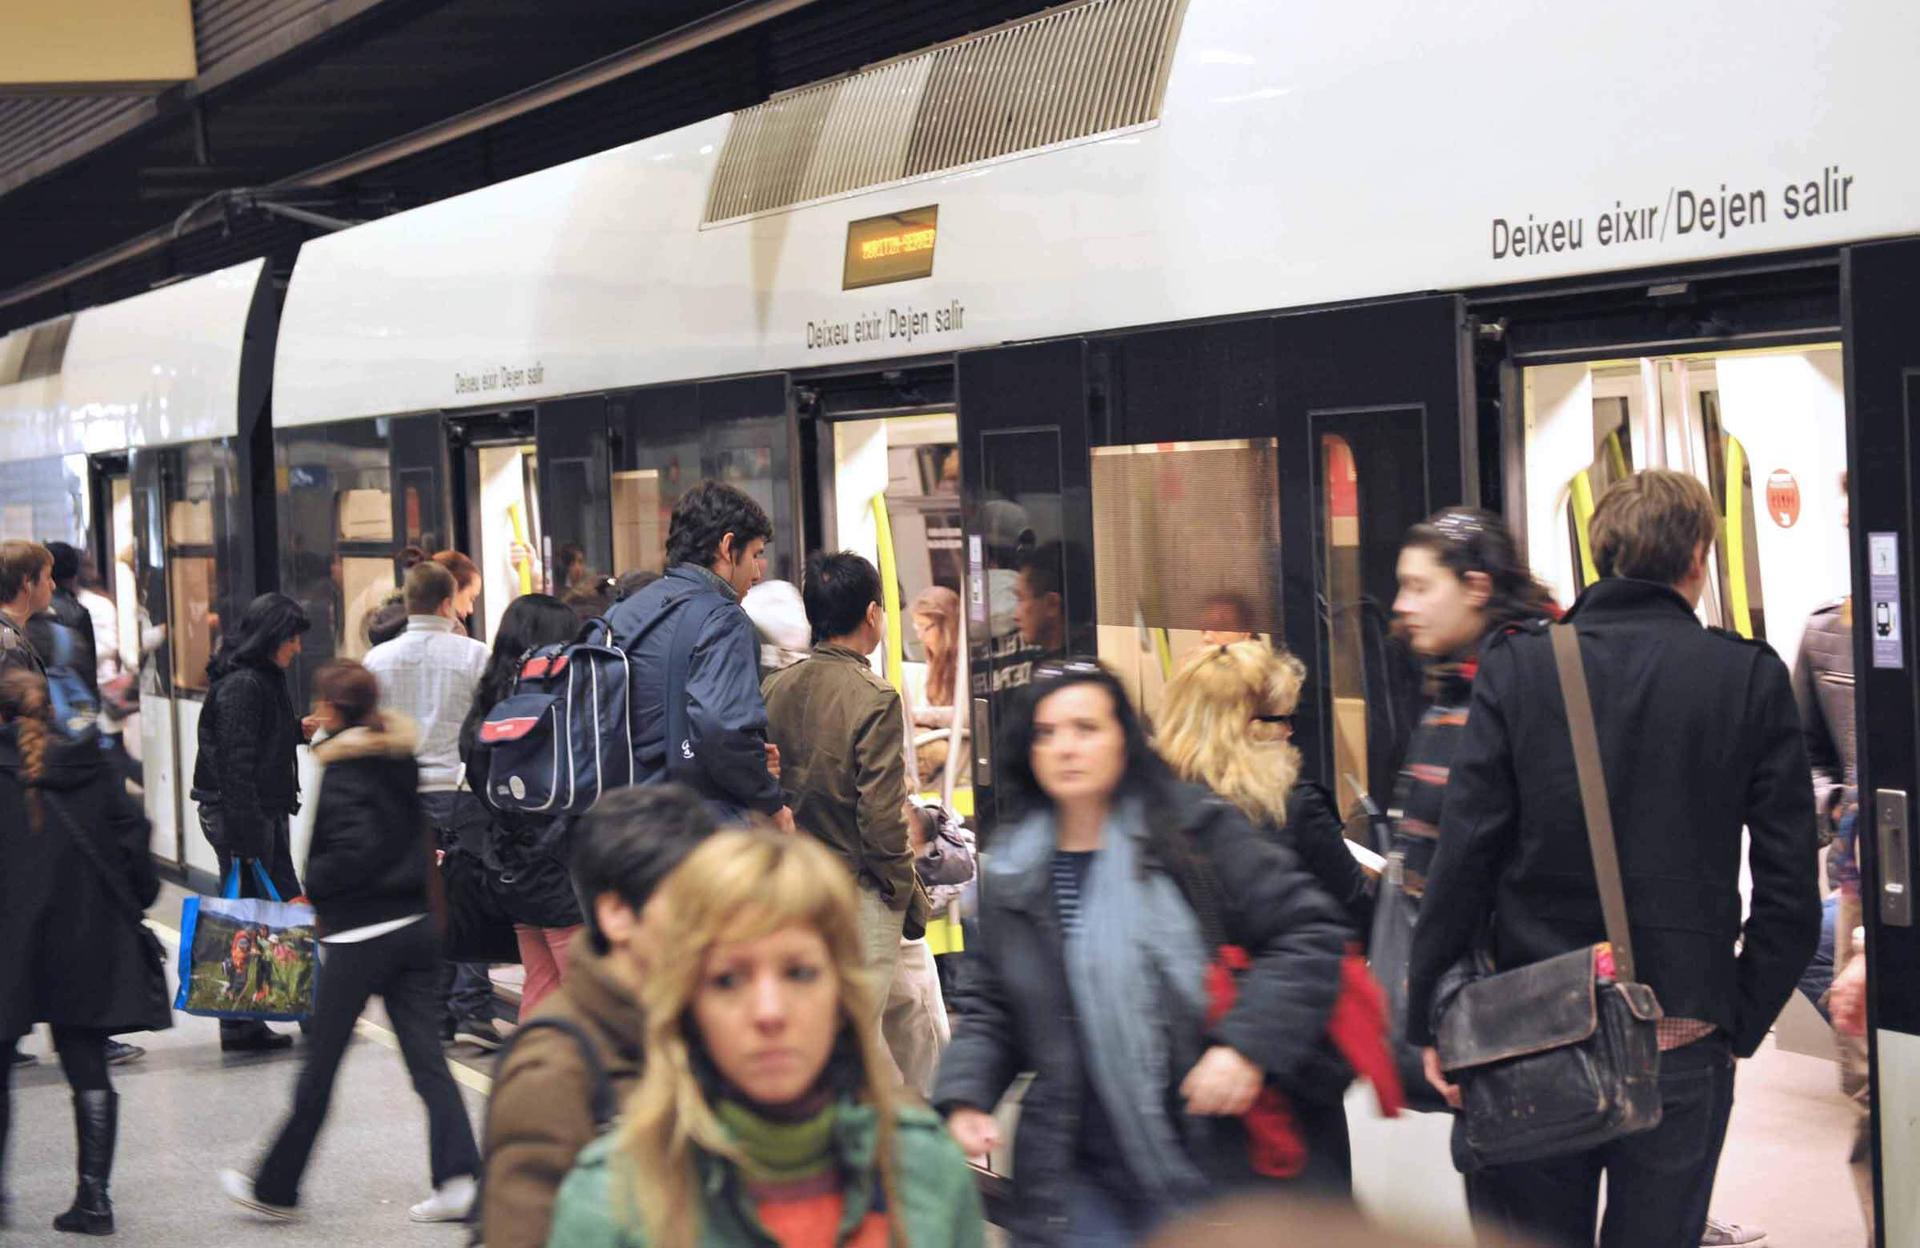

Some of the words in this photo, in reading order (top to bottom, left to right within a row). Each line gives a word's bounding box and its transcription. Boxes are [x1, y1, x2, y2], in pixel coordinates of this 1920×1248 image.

[1492, 213, 1583, 259] Deixeu
[1783, 165, 1854, 219] salir
[806, 319, 849, 349] Deixeu
[935, 299, 965, 332] salir
